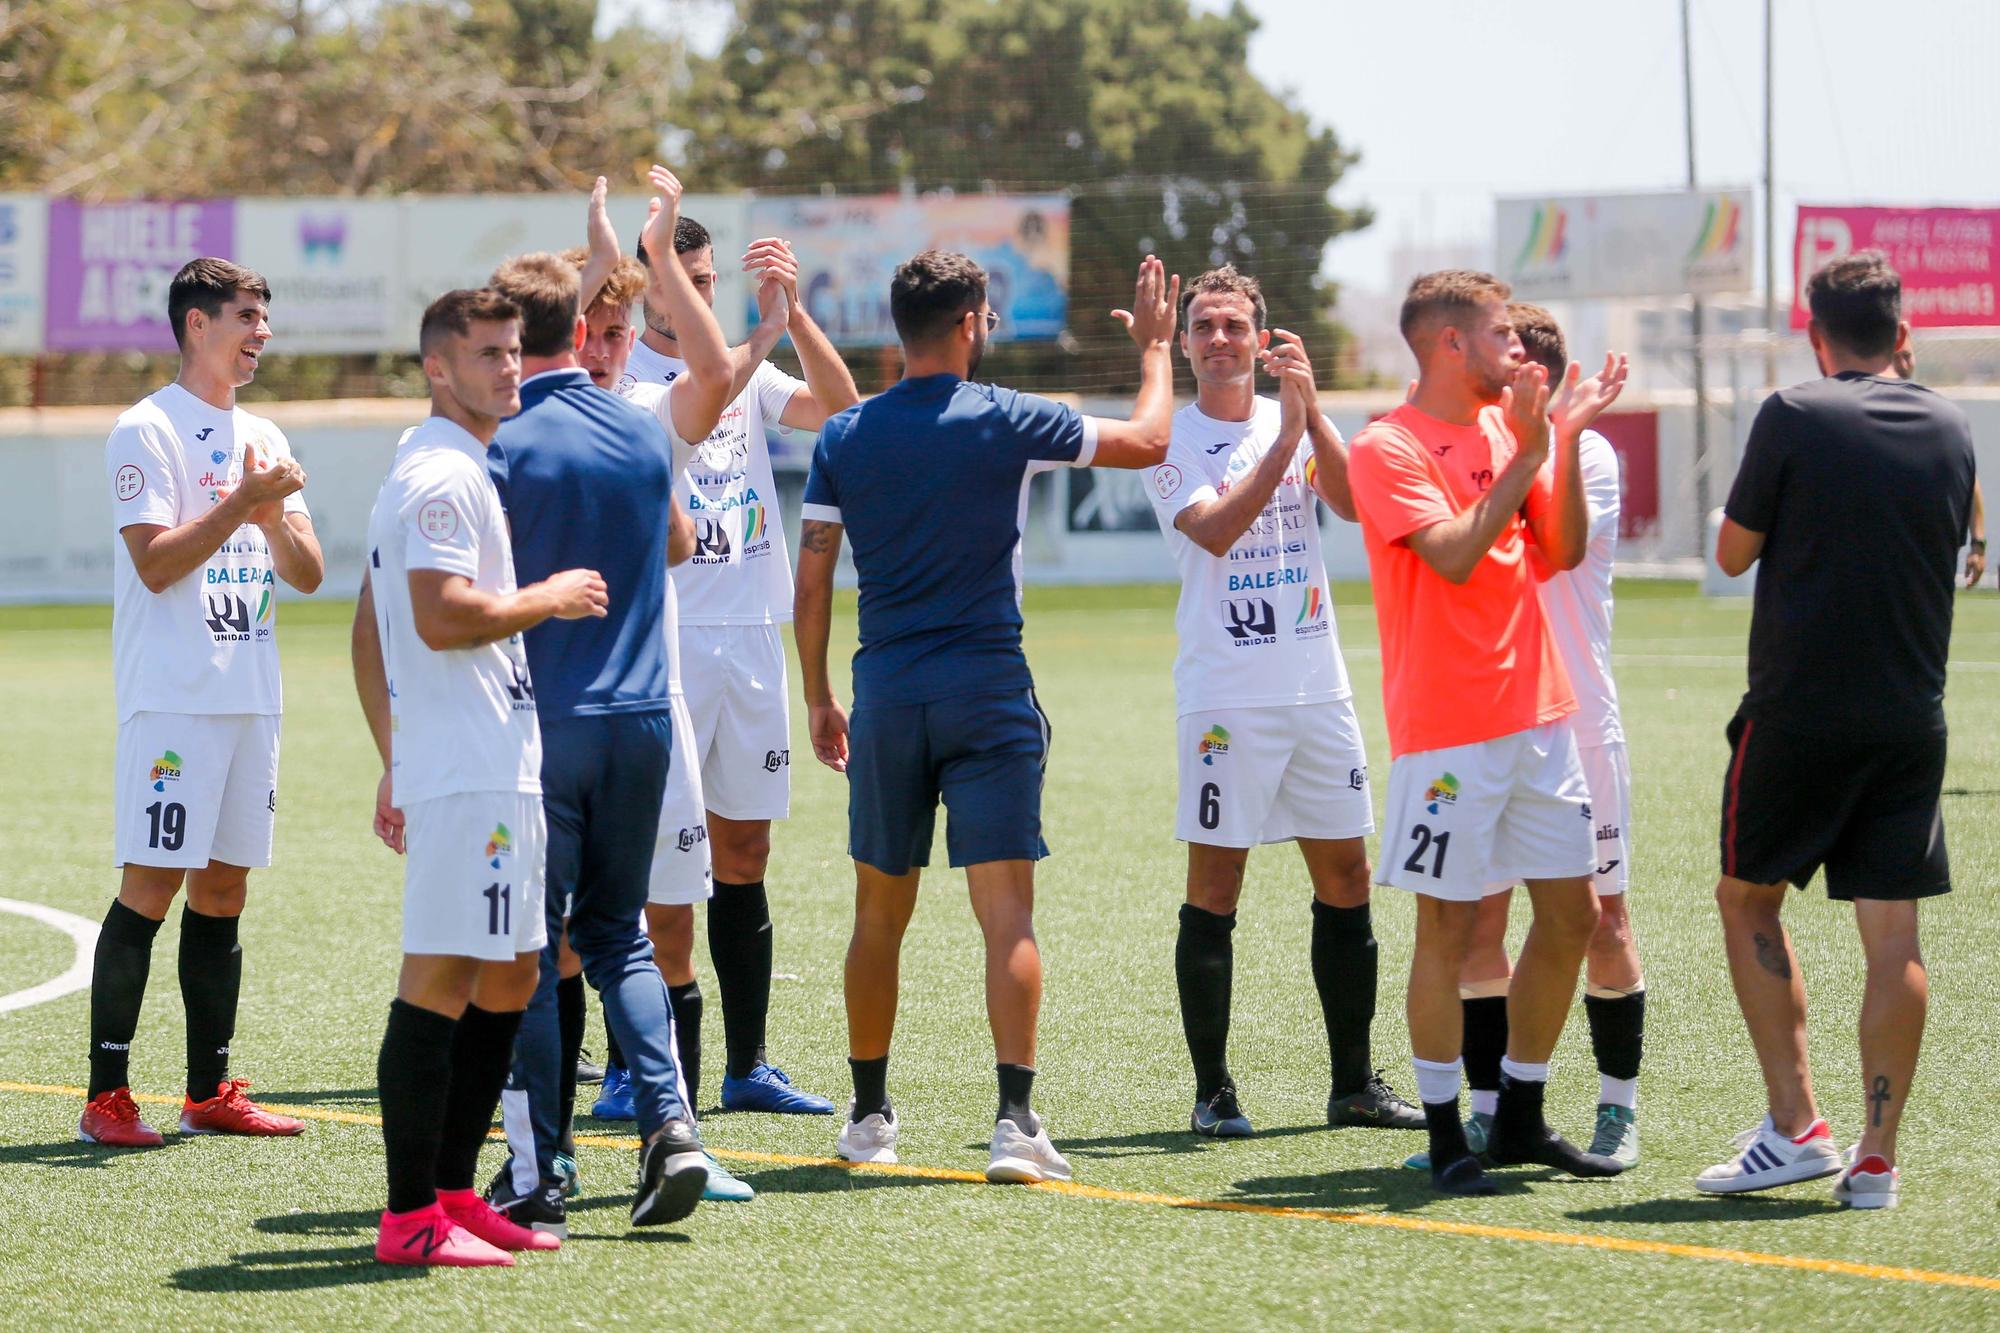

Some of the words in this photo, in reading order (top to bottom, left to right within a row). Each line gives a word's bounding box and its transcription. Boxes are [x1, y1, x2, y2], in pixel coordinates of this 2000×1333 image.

[214, 634, 250, 642] UNIDAD
[1234, 636, 1277, 647] UNIDAD
[145, 801, 187, 851] 19
[1199, 782, 1221, 830] 6
[1403, 824, 1451, 879] 21
[482, 882, 511, 935] 11
